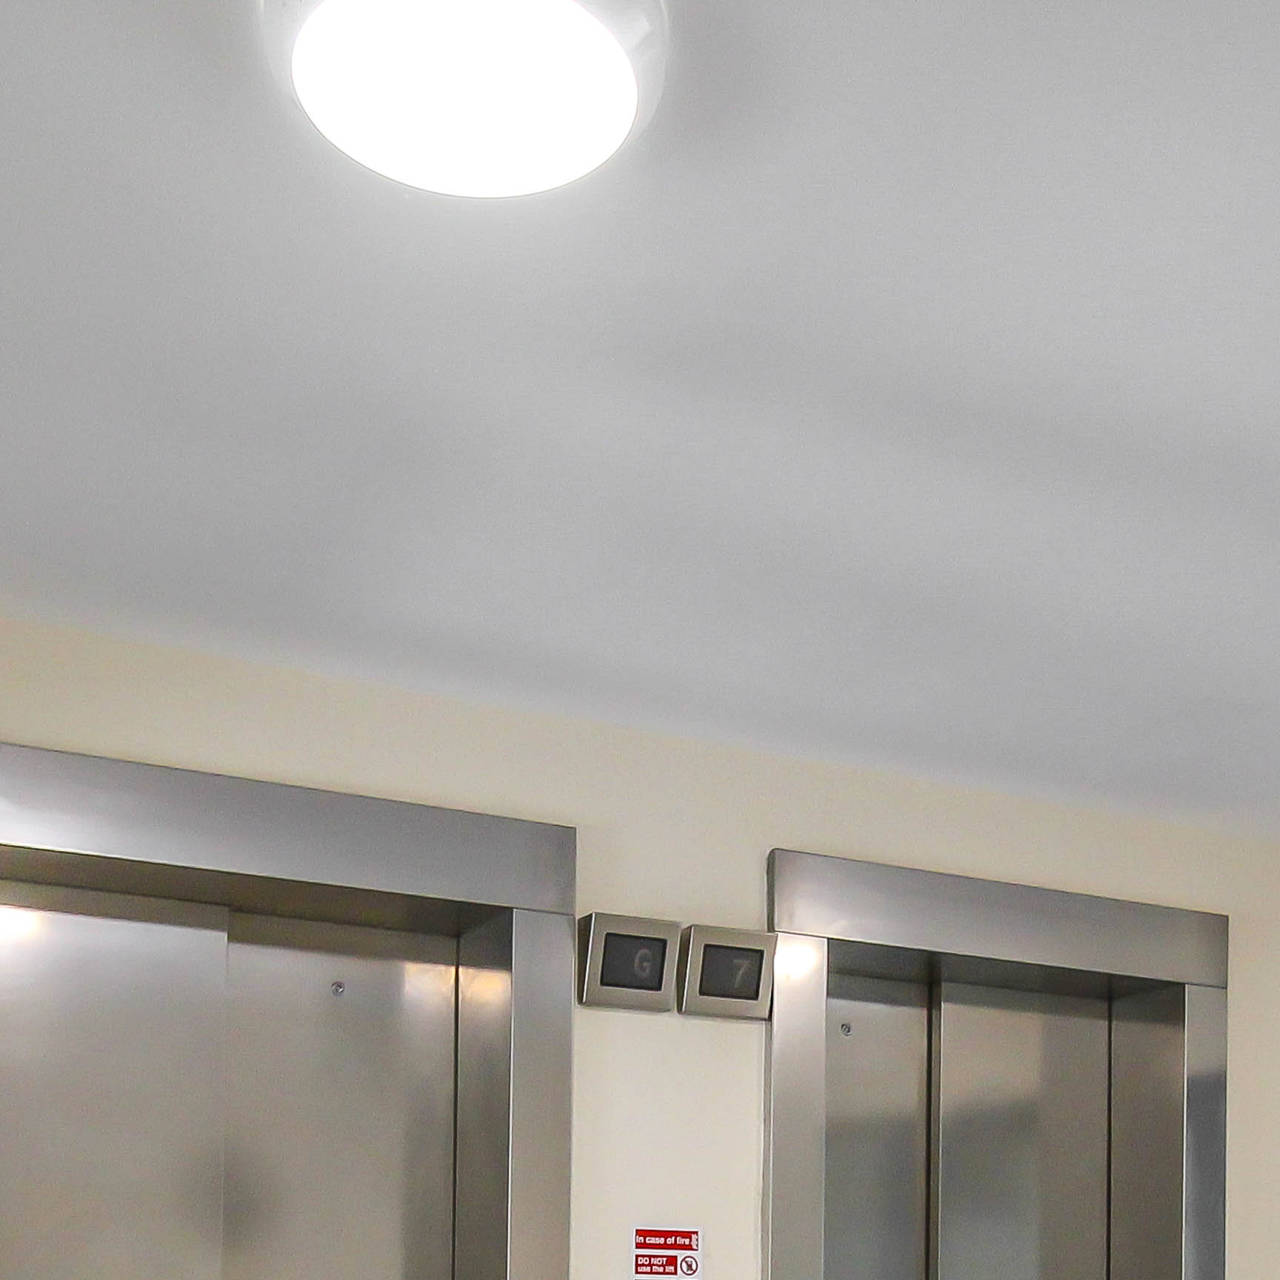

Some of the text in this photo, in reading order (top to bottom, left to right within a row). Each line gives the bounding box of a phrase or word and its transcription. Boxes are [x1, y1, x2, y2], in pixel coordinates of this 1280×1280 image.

[633, 948, 652, 979] G
[733, 959, 752, 989] 7
[667, 1236, 675, 1244] of
